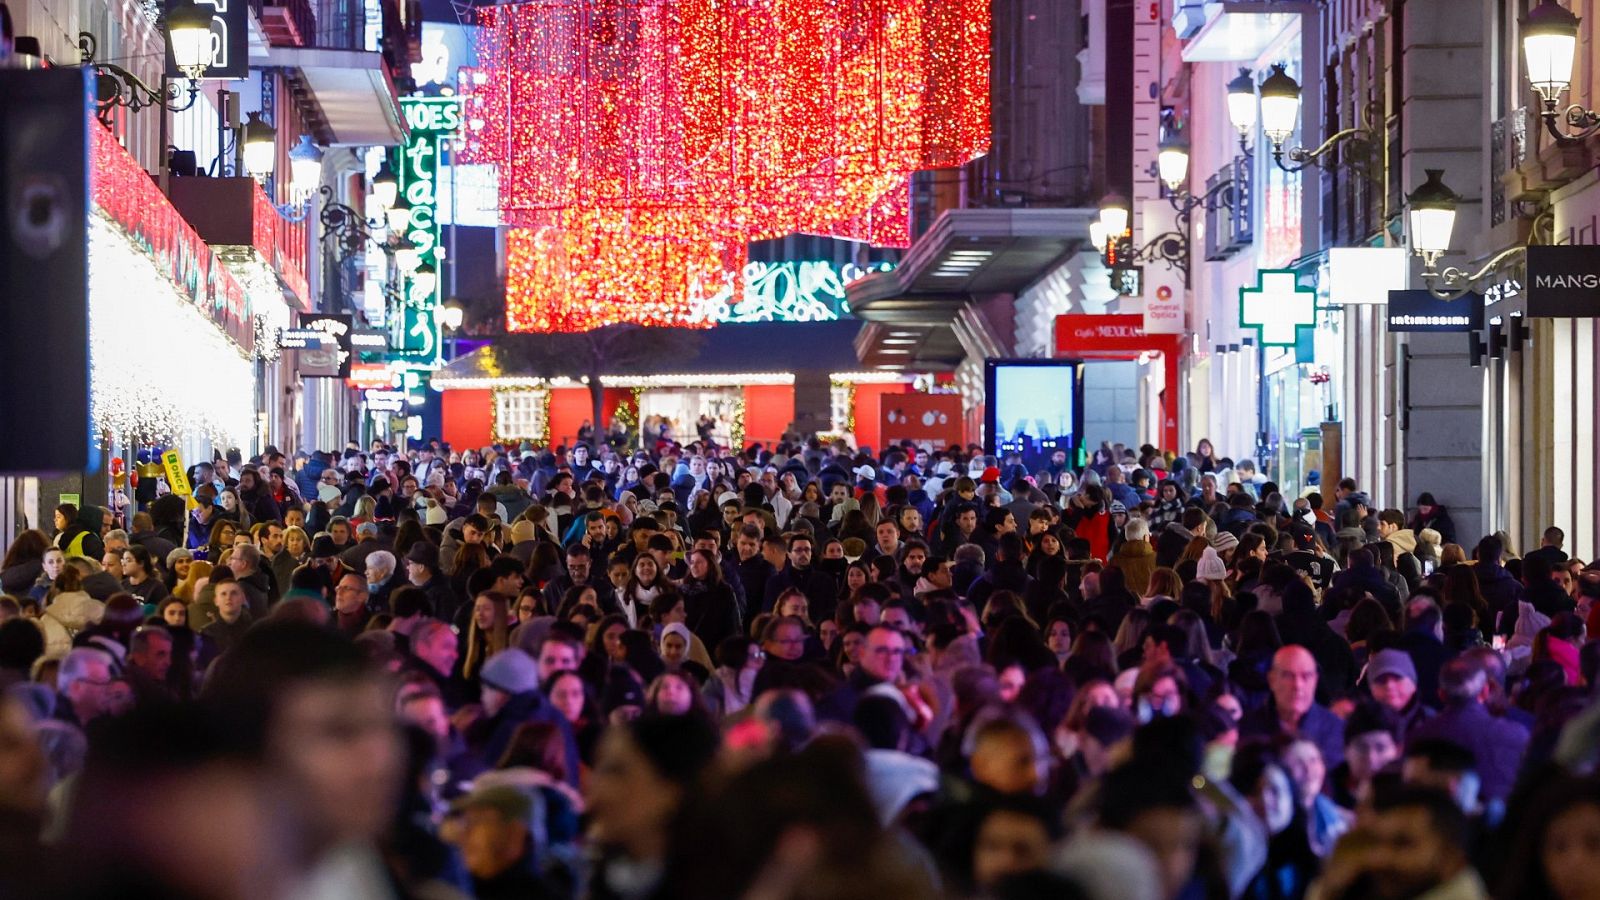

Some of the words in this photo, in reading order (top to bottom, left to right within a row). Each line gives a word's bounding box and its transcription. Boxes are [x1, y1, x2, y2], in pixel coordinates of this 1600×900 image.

[1150, 3, 1158, 20] 5
[402, 103, 459, 130] HOES
[1535, 274, 1600, 288] MANG
[1390, 314, 1469, 325] intimissimi
[172, 465, 184, 490] ONCE
